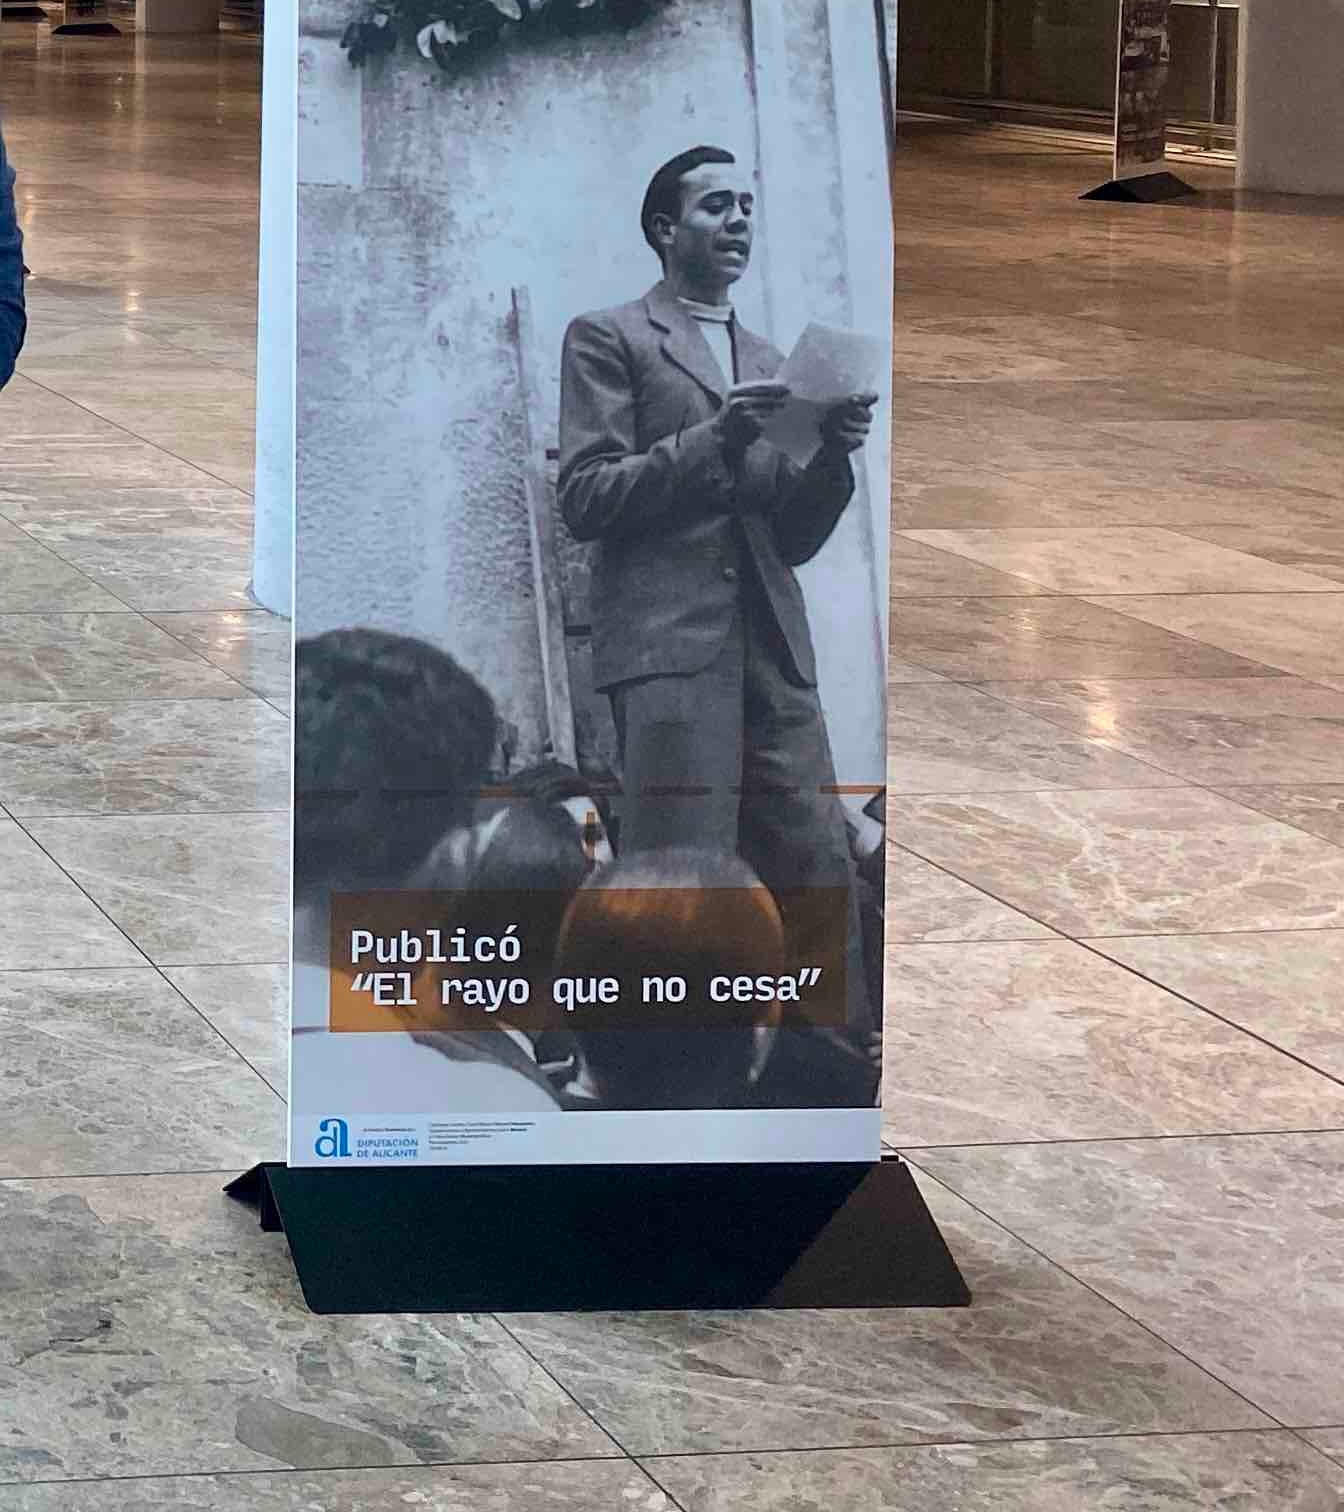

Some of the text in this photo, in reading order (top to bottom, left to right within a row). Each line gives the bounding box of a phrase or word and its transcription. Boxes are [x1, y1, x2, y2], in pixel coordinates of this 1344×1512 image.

[351, 925, 521, 964] Publicó
[442, 978, 530, 1013] rayo
[552, 979, 619, 1011] que
[642, 978, 686, 1002] no
